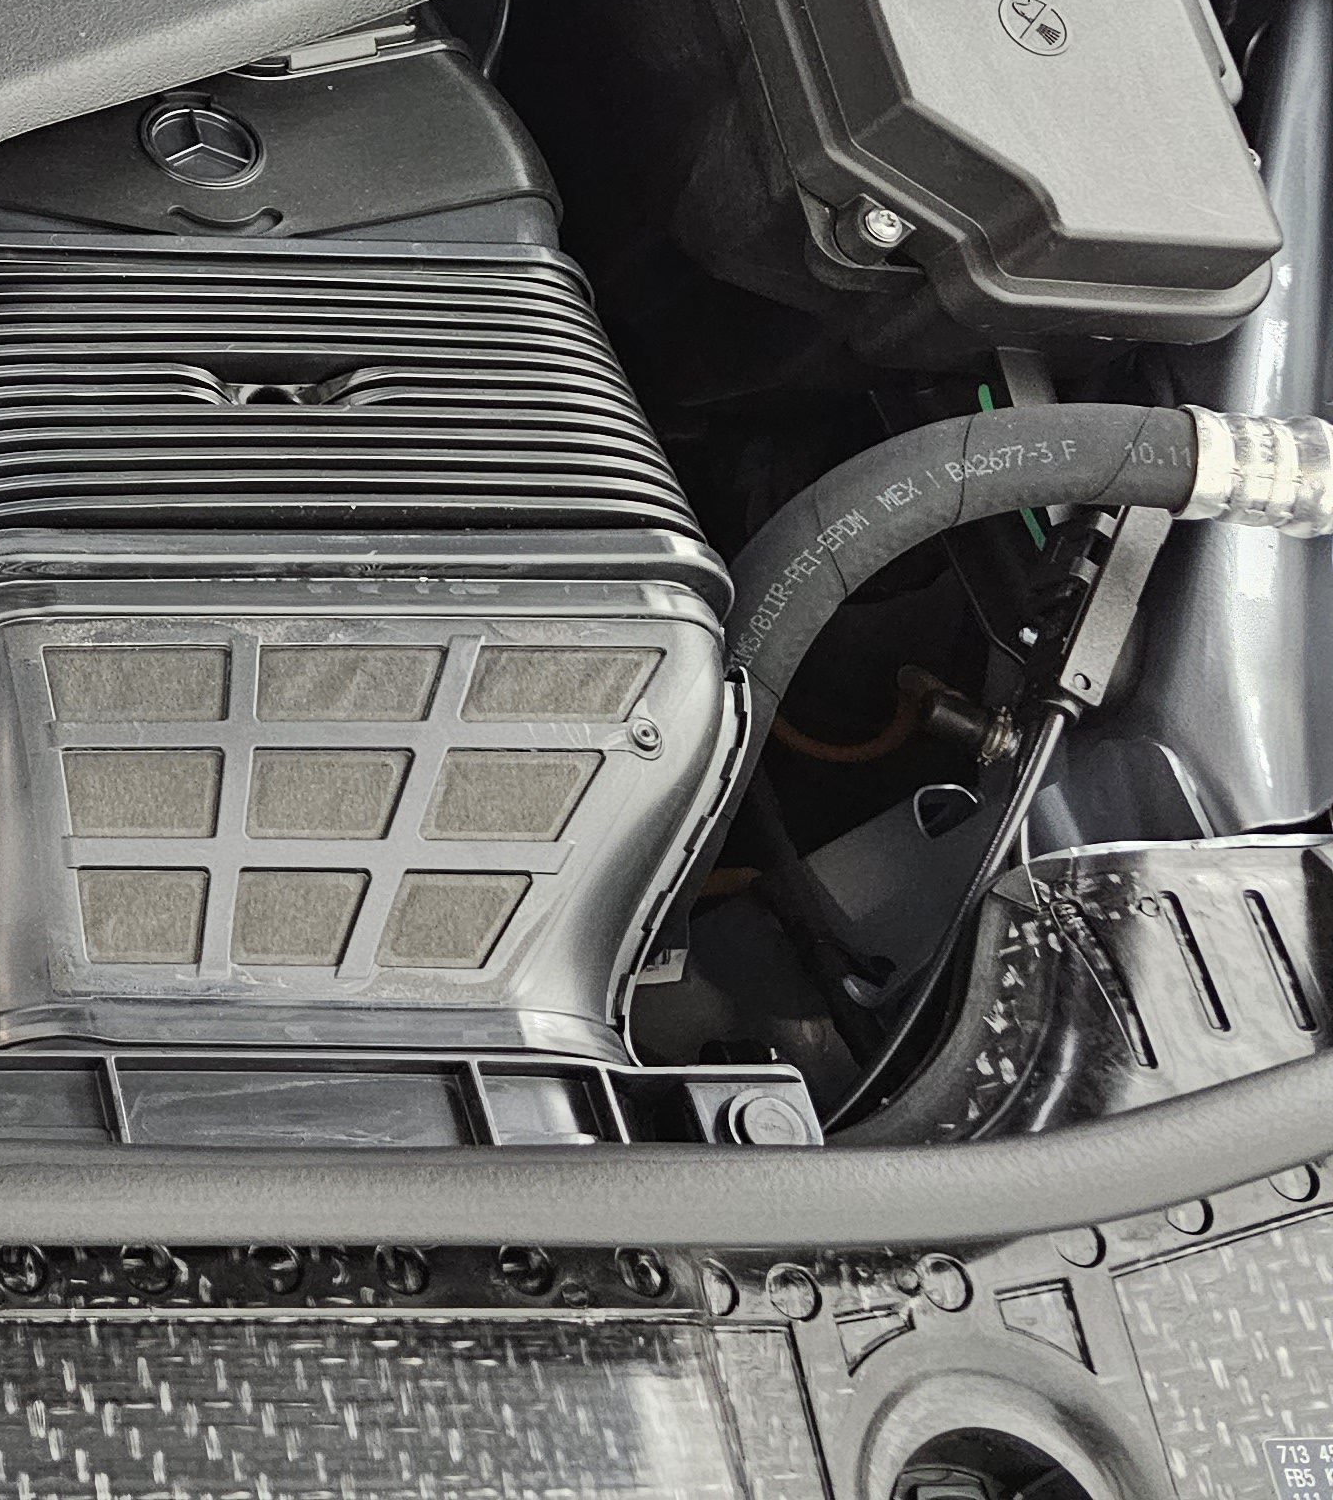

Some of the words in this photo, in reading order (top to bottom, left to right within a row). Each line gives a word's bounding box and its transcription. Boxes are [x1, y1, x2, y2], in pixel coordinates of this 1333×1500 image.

[876, 476, 923, 512] MEX
[944, 441, 1053, 484] BA2677-3
[1062, 440, 1077, 461] F
[1276, 1444, 1311, 1464] 713
[1284, 1467, 1316, 1488] FB5
